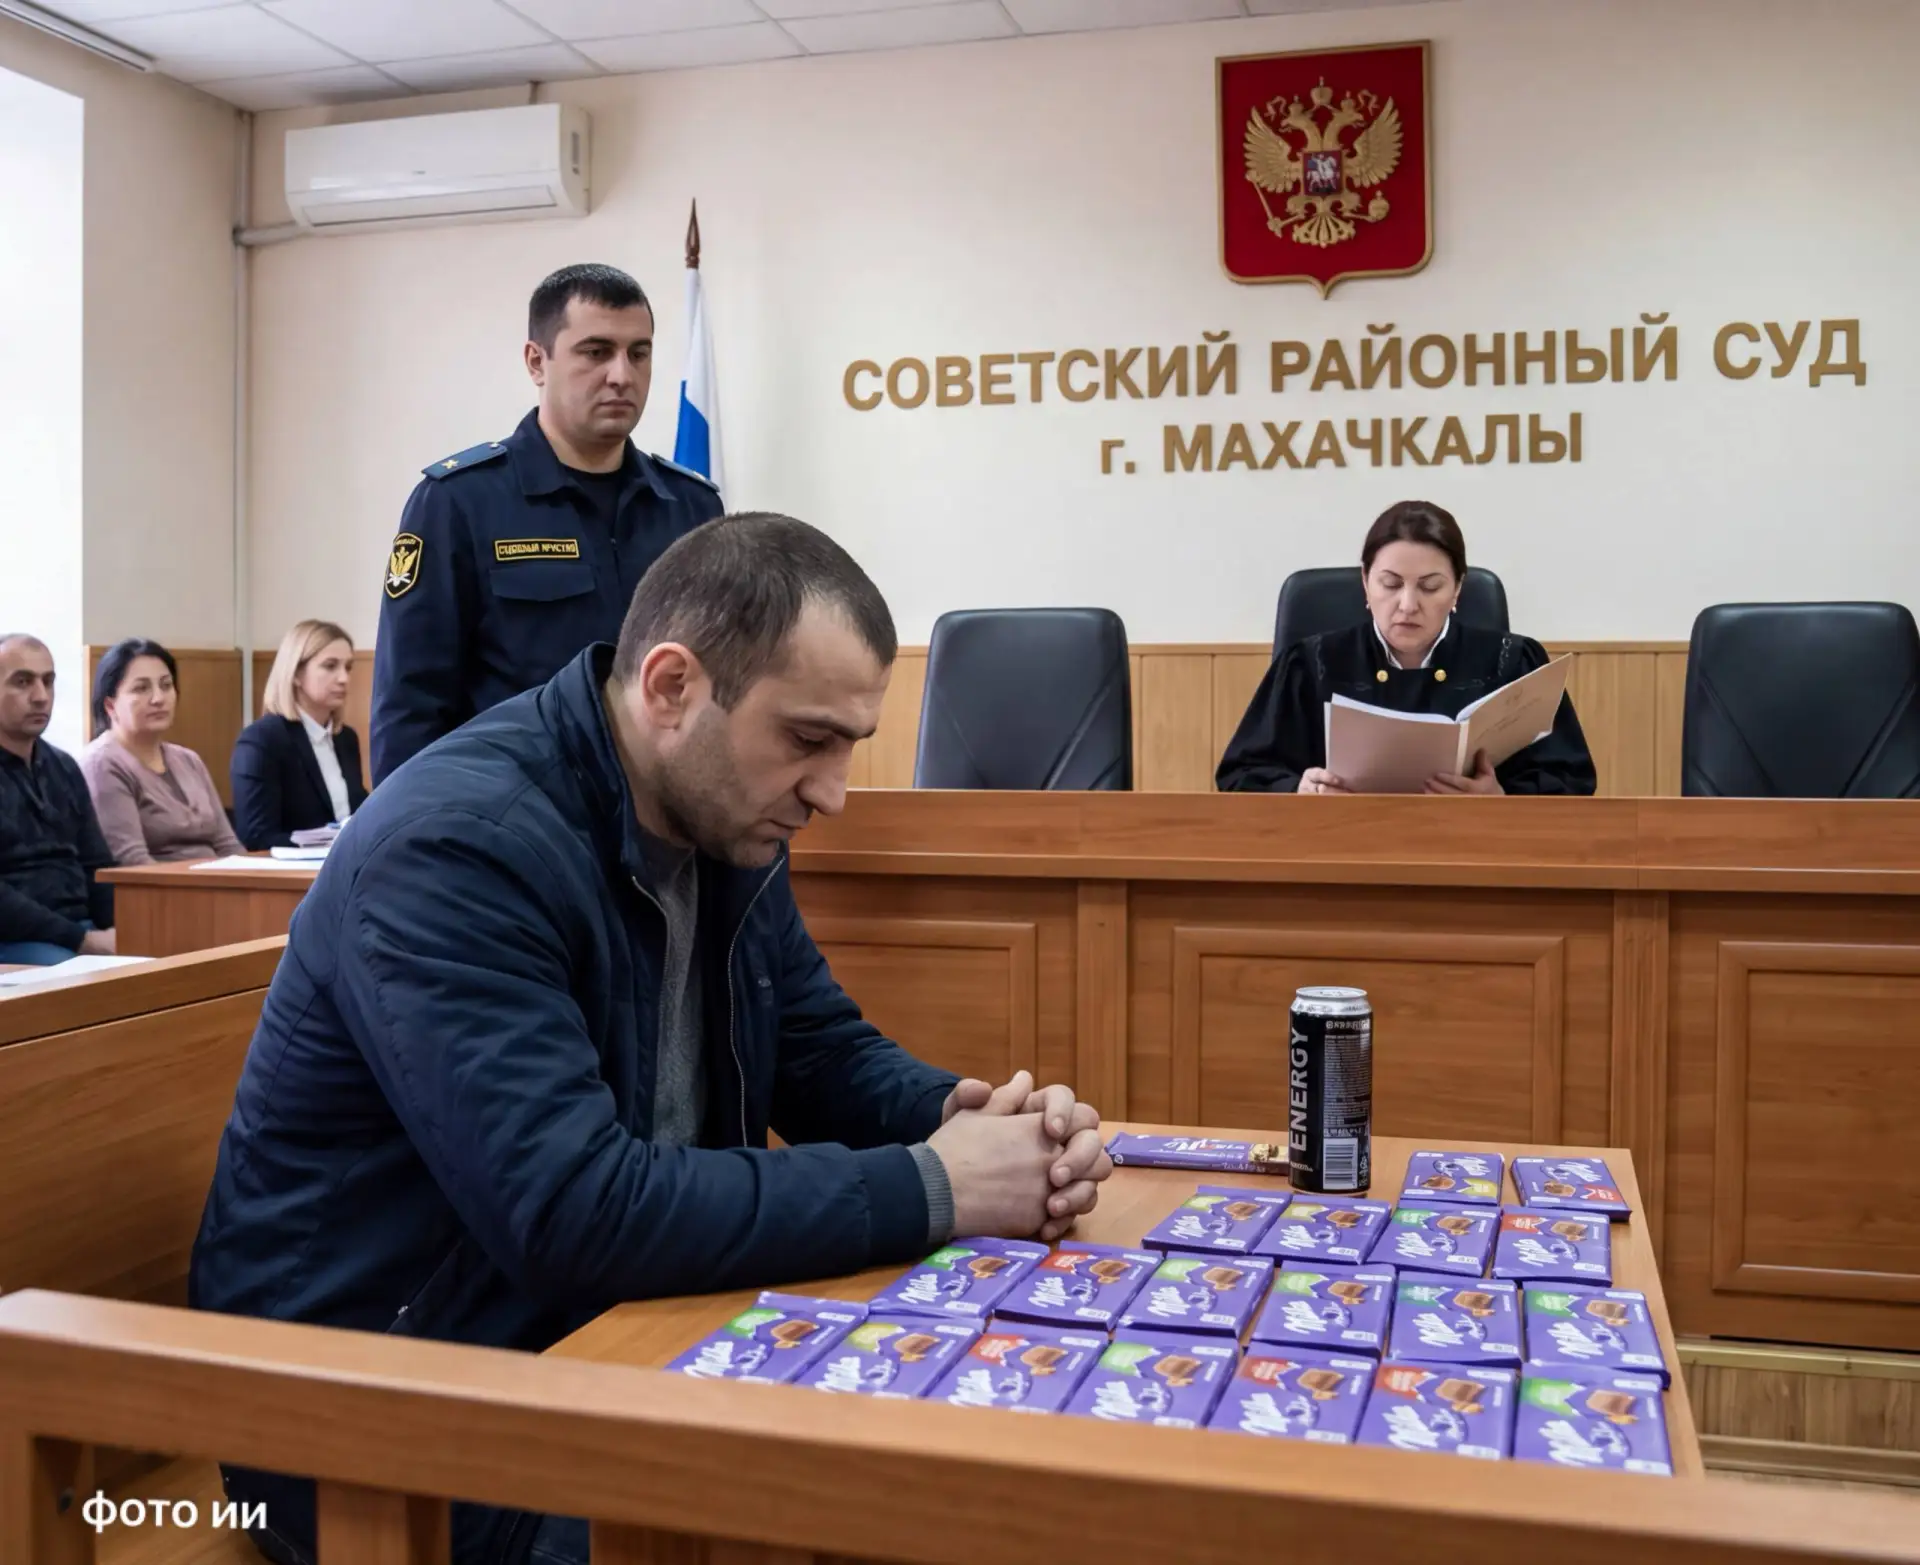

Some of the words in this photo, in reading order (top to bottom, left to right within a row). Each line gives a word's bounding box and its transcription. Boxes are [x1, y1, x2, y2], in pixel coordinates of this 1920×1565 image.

[843, 331, 1237, 411] СОВЕТСКИЙ
[1270, 324, 1677, 391] РАЙОННЫЙ
[1714, 318, 1866, 385] СУД
[1100, 439, 1135, 473] г.
[1163, 411, 1582, 472] МАХАЧКАЛЫ
[1289, 1027, 1308, 1152] ENERGY
